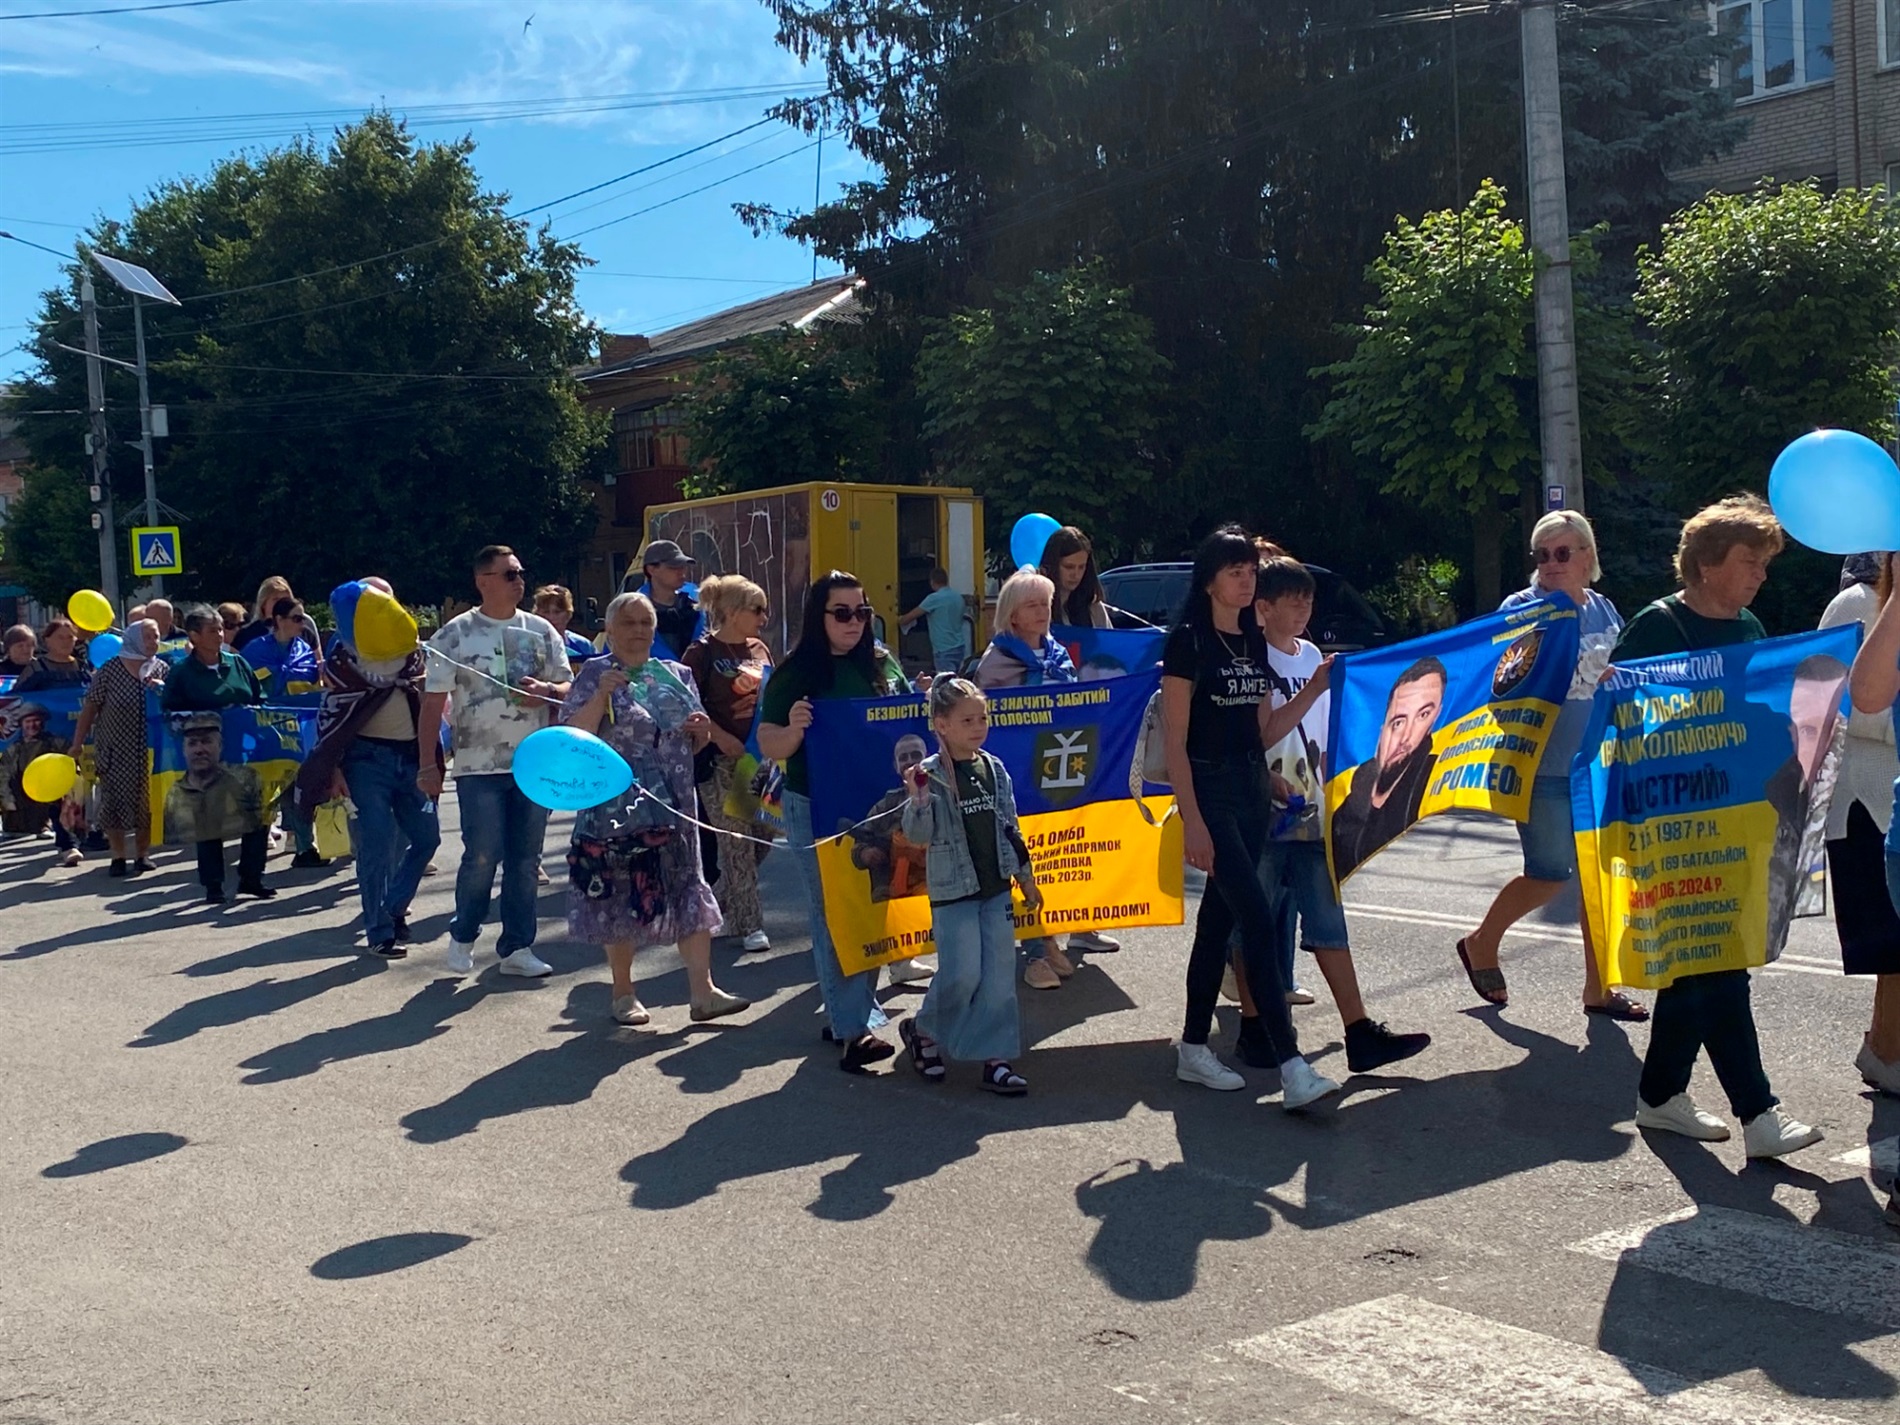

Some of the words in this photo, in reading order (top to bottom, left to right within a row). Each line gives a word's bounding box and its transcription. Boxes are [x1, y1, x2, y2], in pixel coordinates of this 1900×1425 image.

[823, 492, 838, 508] 10
[1228, 679, 1238, 695] Я
[866, 703, 919, 722] БЕЗВІСТІ
[1000, 694, 1054, 711] ЗНАЧИТЬ
[1055, 687, 1111, 707] ЗАБУТИЙ!
[995, 710, 1053, 727] ГОЛОСОМ!
[1027, 833, 1045, 850] 54
[1062, 840, 1122, 854] НАПРЯМОК
[1034, 856, 1093, 873] ЯКОВЛІВКА
[1044, 907, 1090, 924] ТАТУСЯ
[1092, 902, 1151, 921] ДОДОМУ!
[900, 932, 913, 947] ТА
